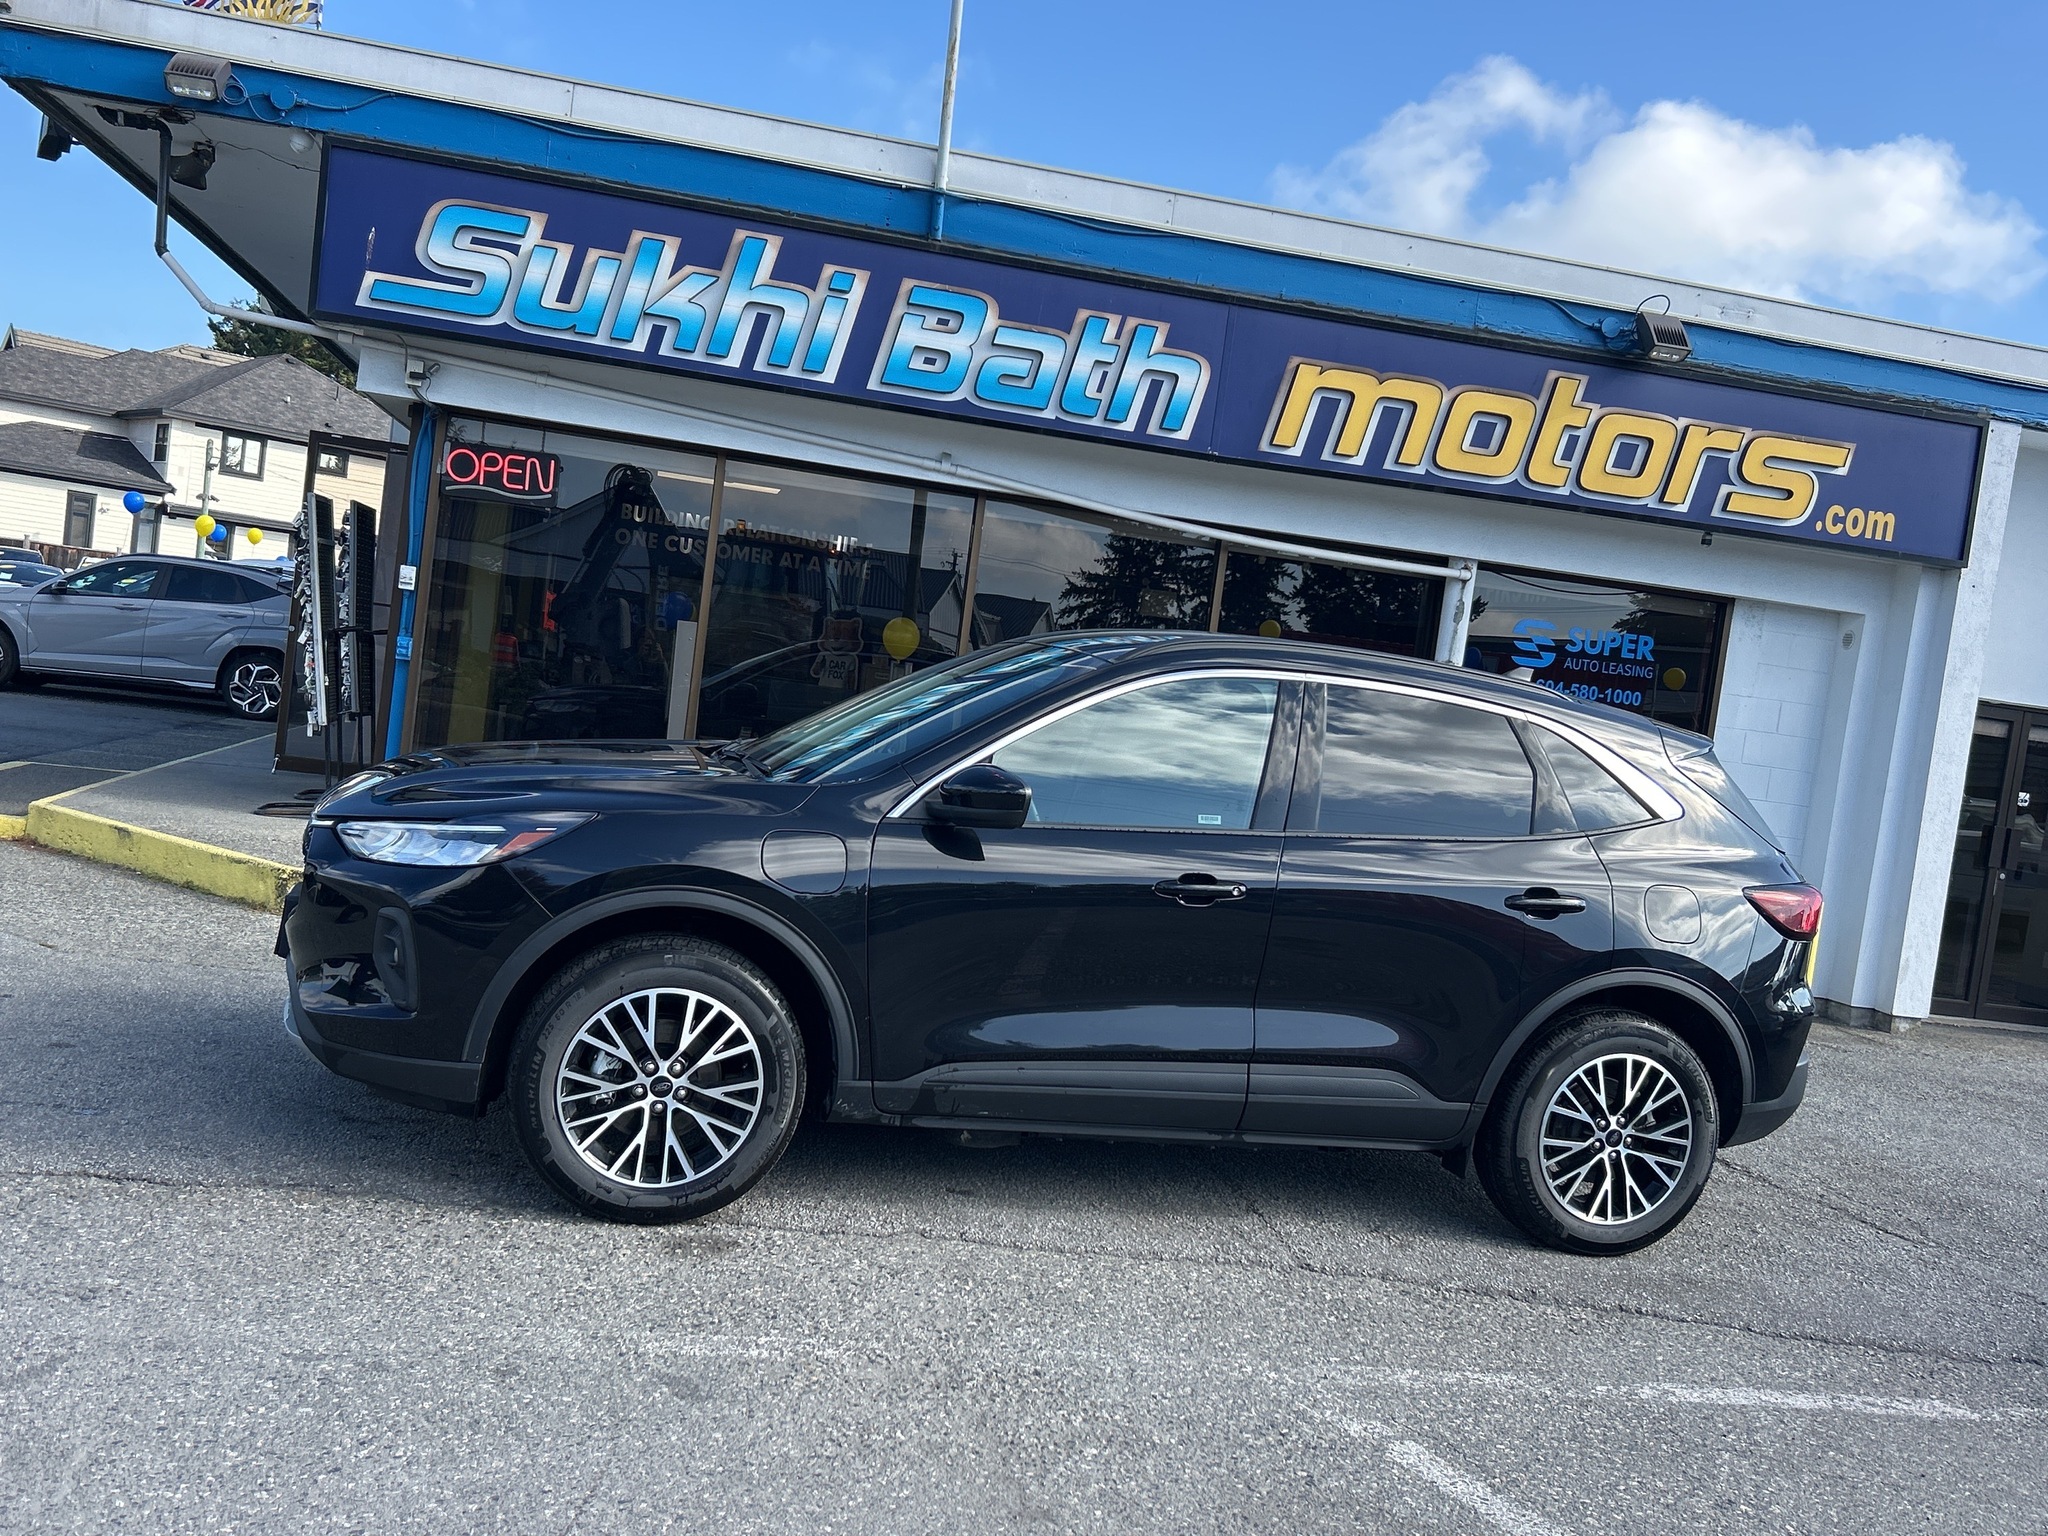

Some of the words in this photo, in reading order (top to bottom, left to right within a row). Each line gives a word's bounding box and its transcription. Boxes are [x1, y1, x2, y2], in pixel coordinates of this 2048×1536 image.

[357, 198, 871, 384] Sukhi
[867, 277, 1211, 440] Bath
[445, 448, 555, 493] OPEN
[615, 528, 659, 549] ONE
[664, 535, 774, 565] CUSOMER
[779, 551, 804, 569] AT
[806, 555, 821, 573] A
[826, 558, 872, 580] TIME
[1564, 626, 1656, 662] SUPER
[827, 669, 844, 680] FOX
[829, 660, 846, 671] CAR
[1563, 657, 1600, 673] AUTO
[1602, 661, 1654, 679] LEASING
[527, 1050, 543, 1129] MICHELIN
[542, 1022, 555, 1041] 225
